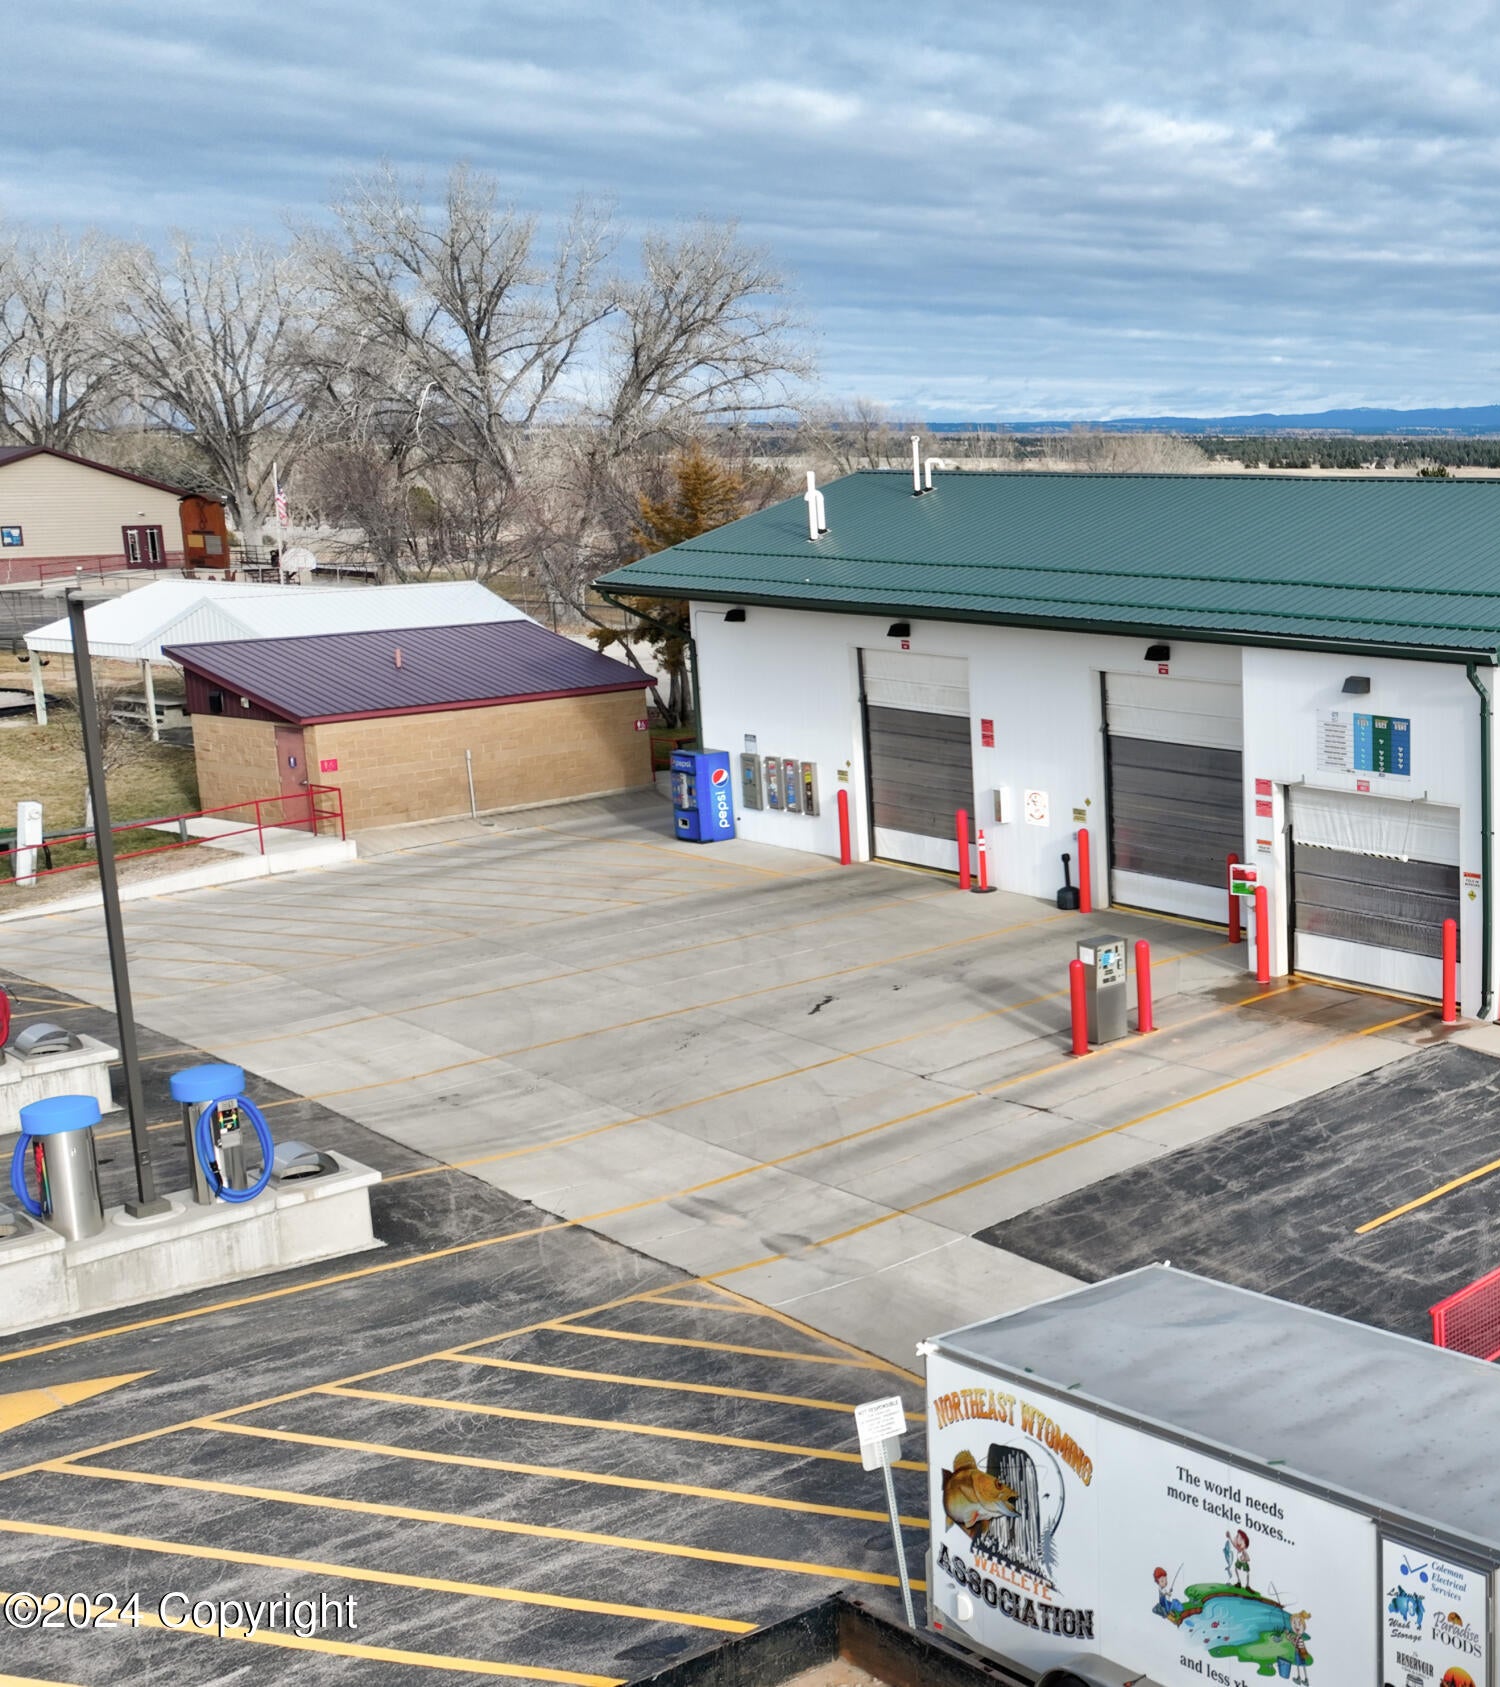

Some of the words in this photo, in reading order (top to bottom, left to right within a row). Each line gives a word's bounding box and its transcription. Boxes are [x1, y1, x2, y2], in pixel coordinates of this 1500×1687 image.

[715, 790, 730, 828] pepsi
[934, 1388, 1016, 1429] NORTHEAST
[1020, 1402, 1093, 1487] WYOMING
[1167, 1485, 1199, 1508] more
[1203, 1498, 1241, 1524] tackle
[1176, 1466, 1200, 1487] The
[1204, 1479, 1241, 1503] world
[1245, 1494, 1284, 1520] needs
[974, 1554, 1052, 1601] WALLEYE
[1431, 1561, 1464, 1580] Coleman
[1431, 1573, 1467, 1592] Electrical
[937, 1543, 1095, 1639] ASSOCIATION
[1430, 1584, 1462, 1601] Services
[1432, 1628, 1483, 1658] FOODS
[1433, 1611, 1480, 1643] Paradise
[1180, 1655, 1203, 1674] and
[1207, 1663, 1231, 1687] less
